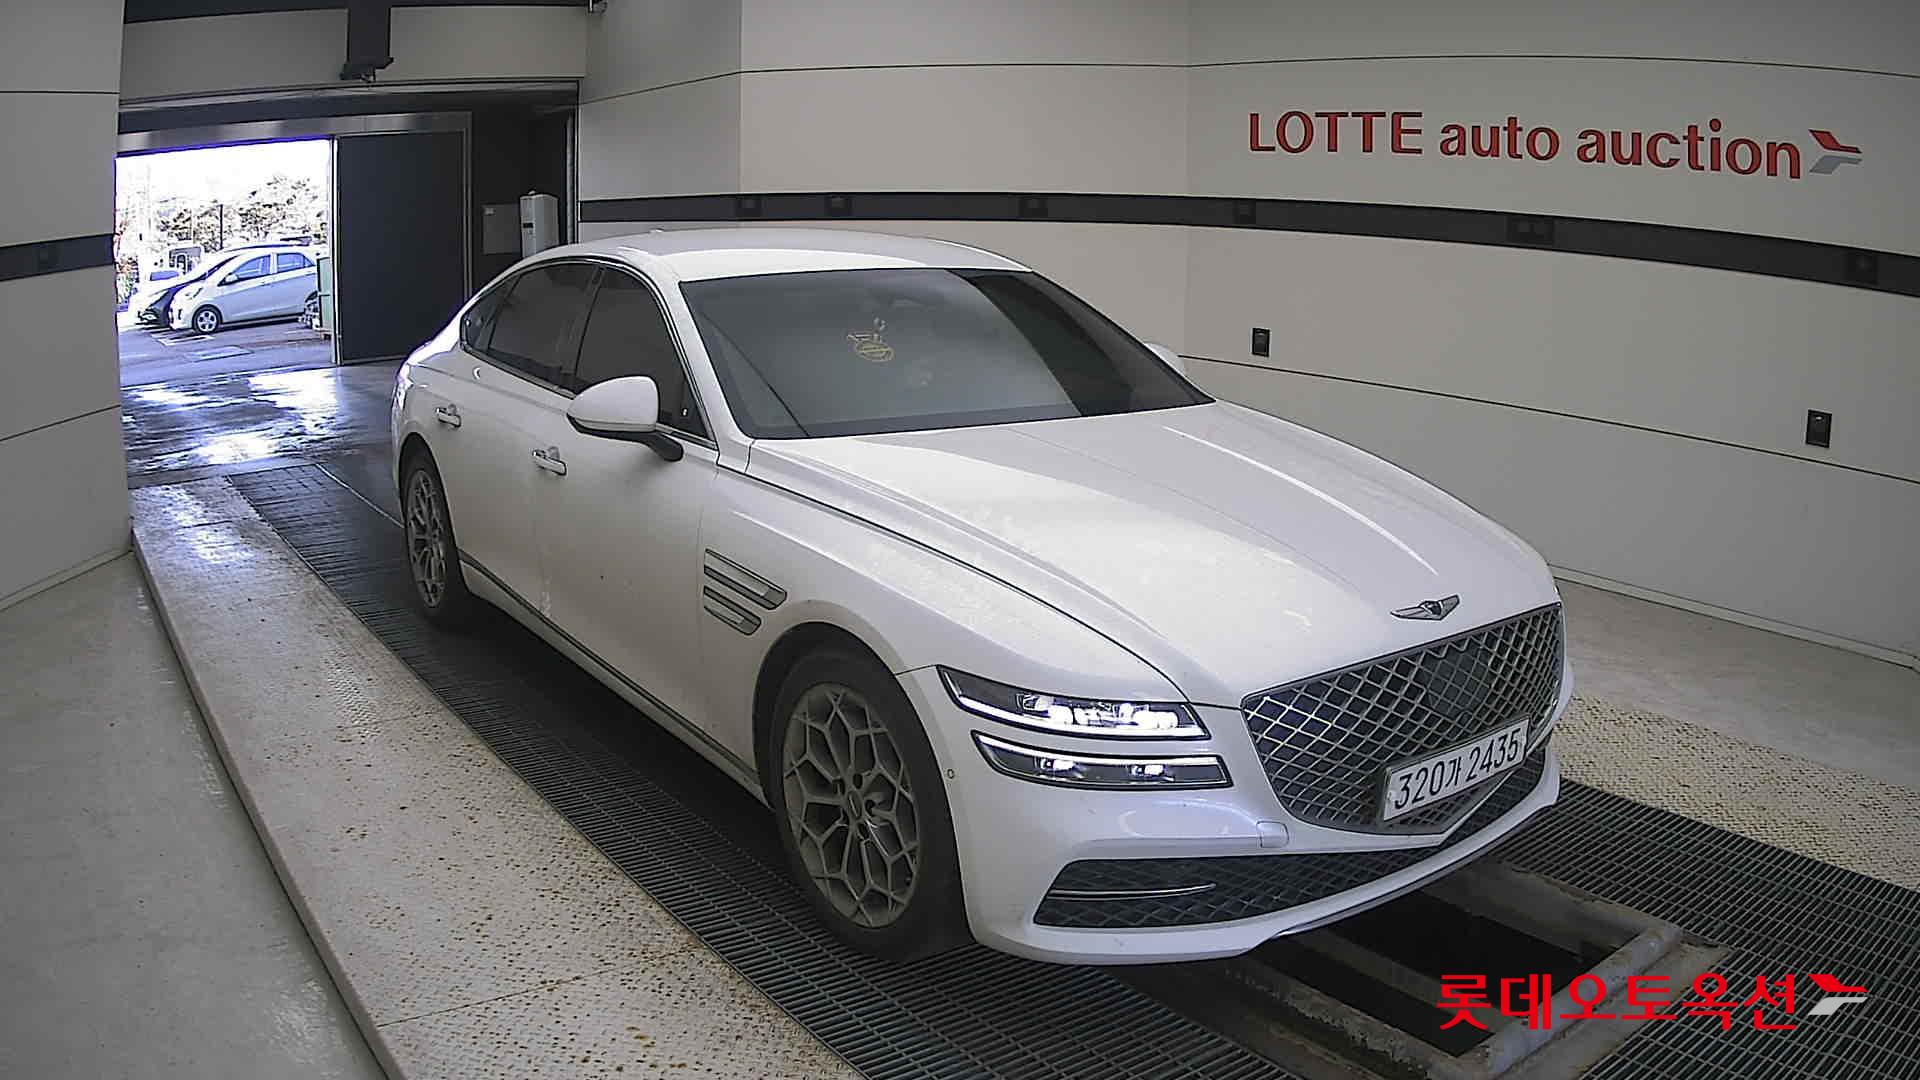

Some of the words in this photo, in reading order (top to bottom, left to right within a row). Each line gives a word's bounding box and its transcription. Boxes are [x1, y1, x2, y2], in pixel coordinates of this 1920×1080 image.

[1249, 111, 1423, 155] LOTTE
[1439, 116, 1560, 161] auto
[1576, 118, 1802, 180] auction
[1394, 756, 1462, 810] 320가
[1465, 727, 1521, 782] 2435
